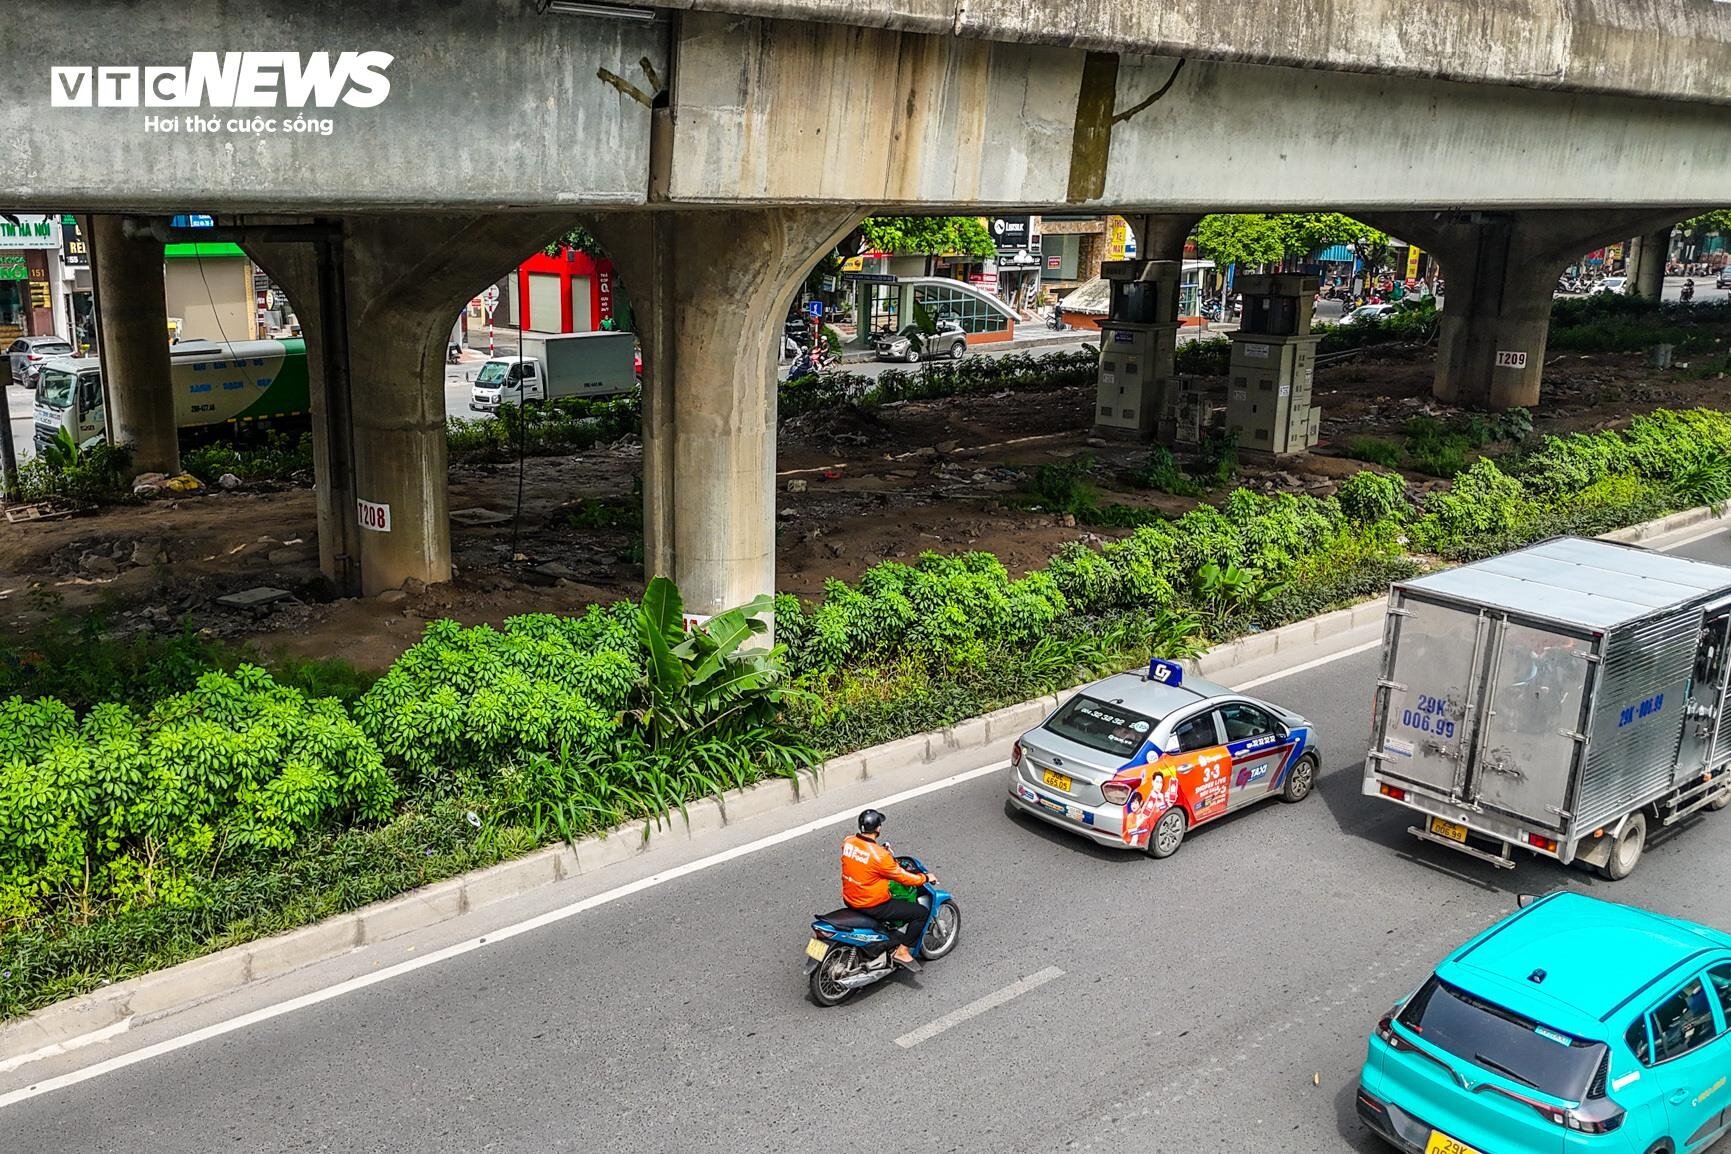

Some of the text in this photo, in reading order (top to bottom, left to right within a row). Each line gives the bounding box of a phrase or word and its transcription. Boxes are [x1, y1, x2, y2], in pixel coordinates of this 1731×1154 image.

[32, 269, 45, 277] 151
[1499, 353, 1525, 365] T209
[359, 502, 386, 529] T208
[1417, 694, 1447, 716] 29K
[1403, 709, 1455, 738] 006.99
[1251, 764, 1268, 779] TAXI
[1435, 825, 1462, 840] 006.99
